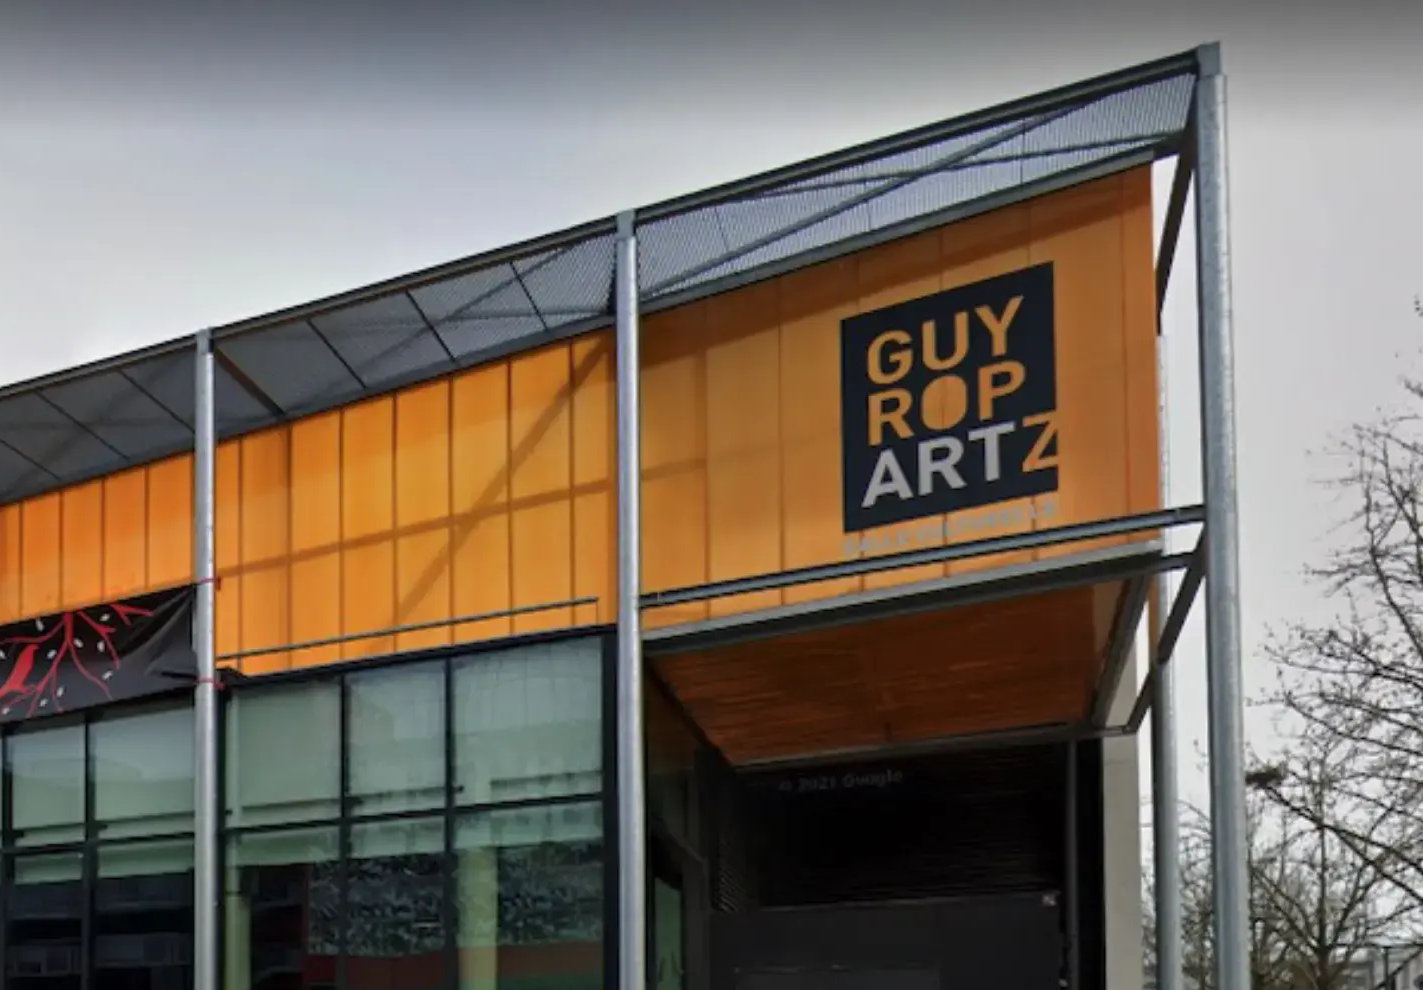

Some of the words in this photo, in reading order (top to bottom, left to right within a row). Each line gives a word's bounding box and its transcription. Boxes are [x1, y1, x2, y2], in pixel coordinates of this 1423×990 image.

[866, 294, 1024, 386] GUY
[867, 360, 1026, 447] ROP
[861, 411, 1059, 509] ARTZ
